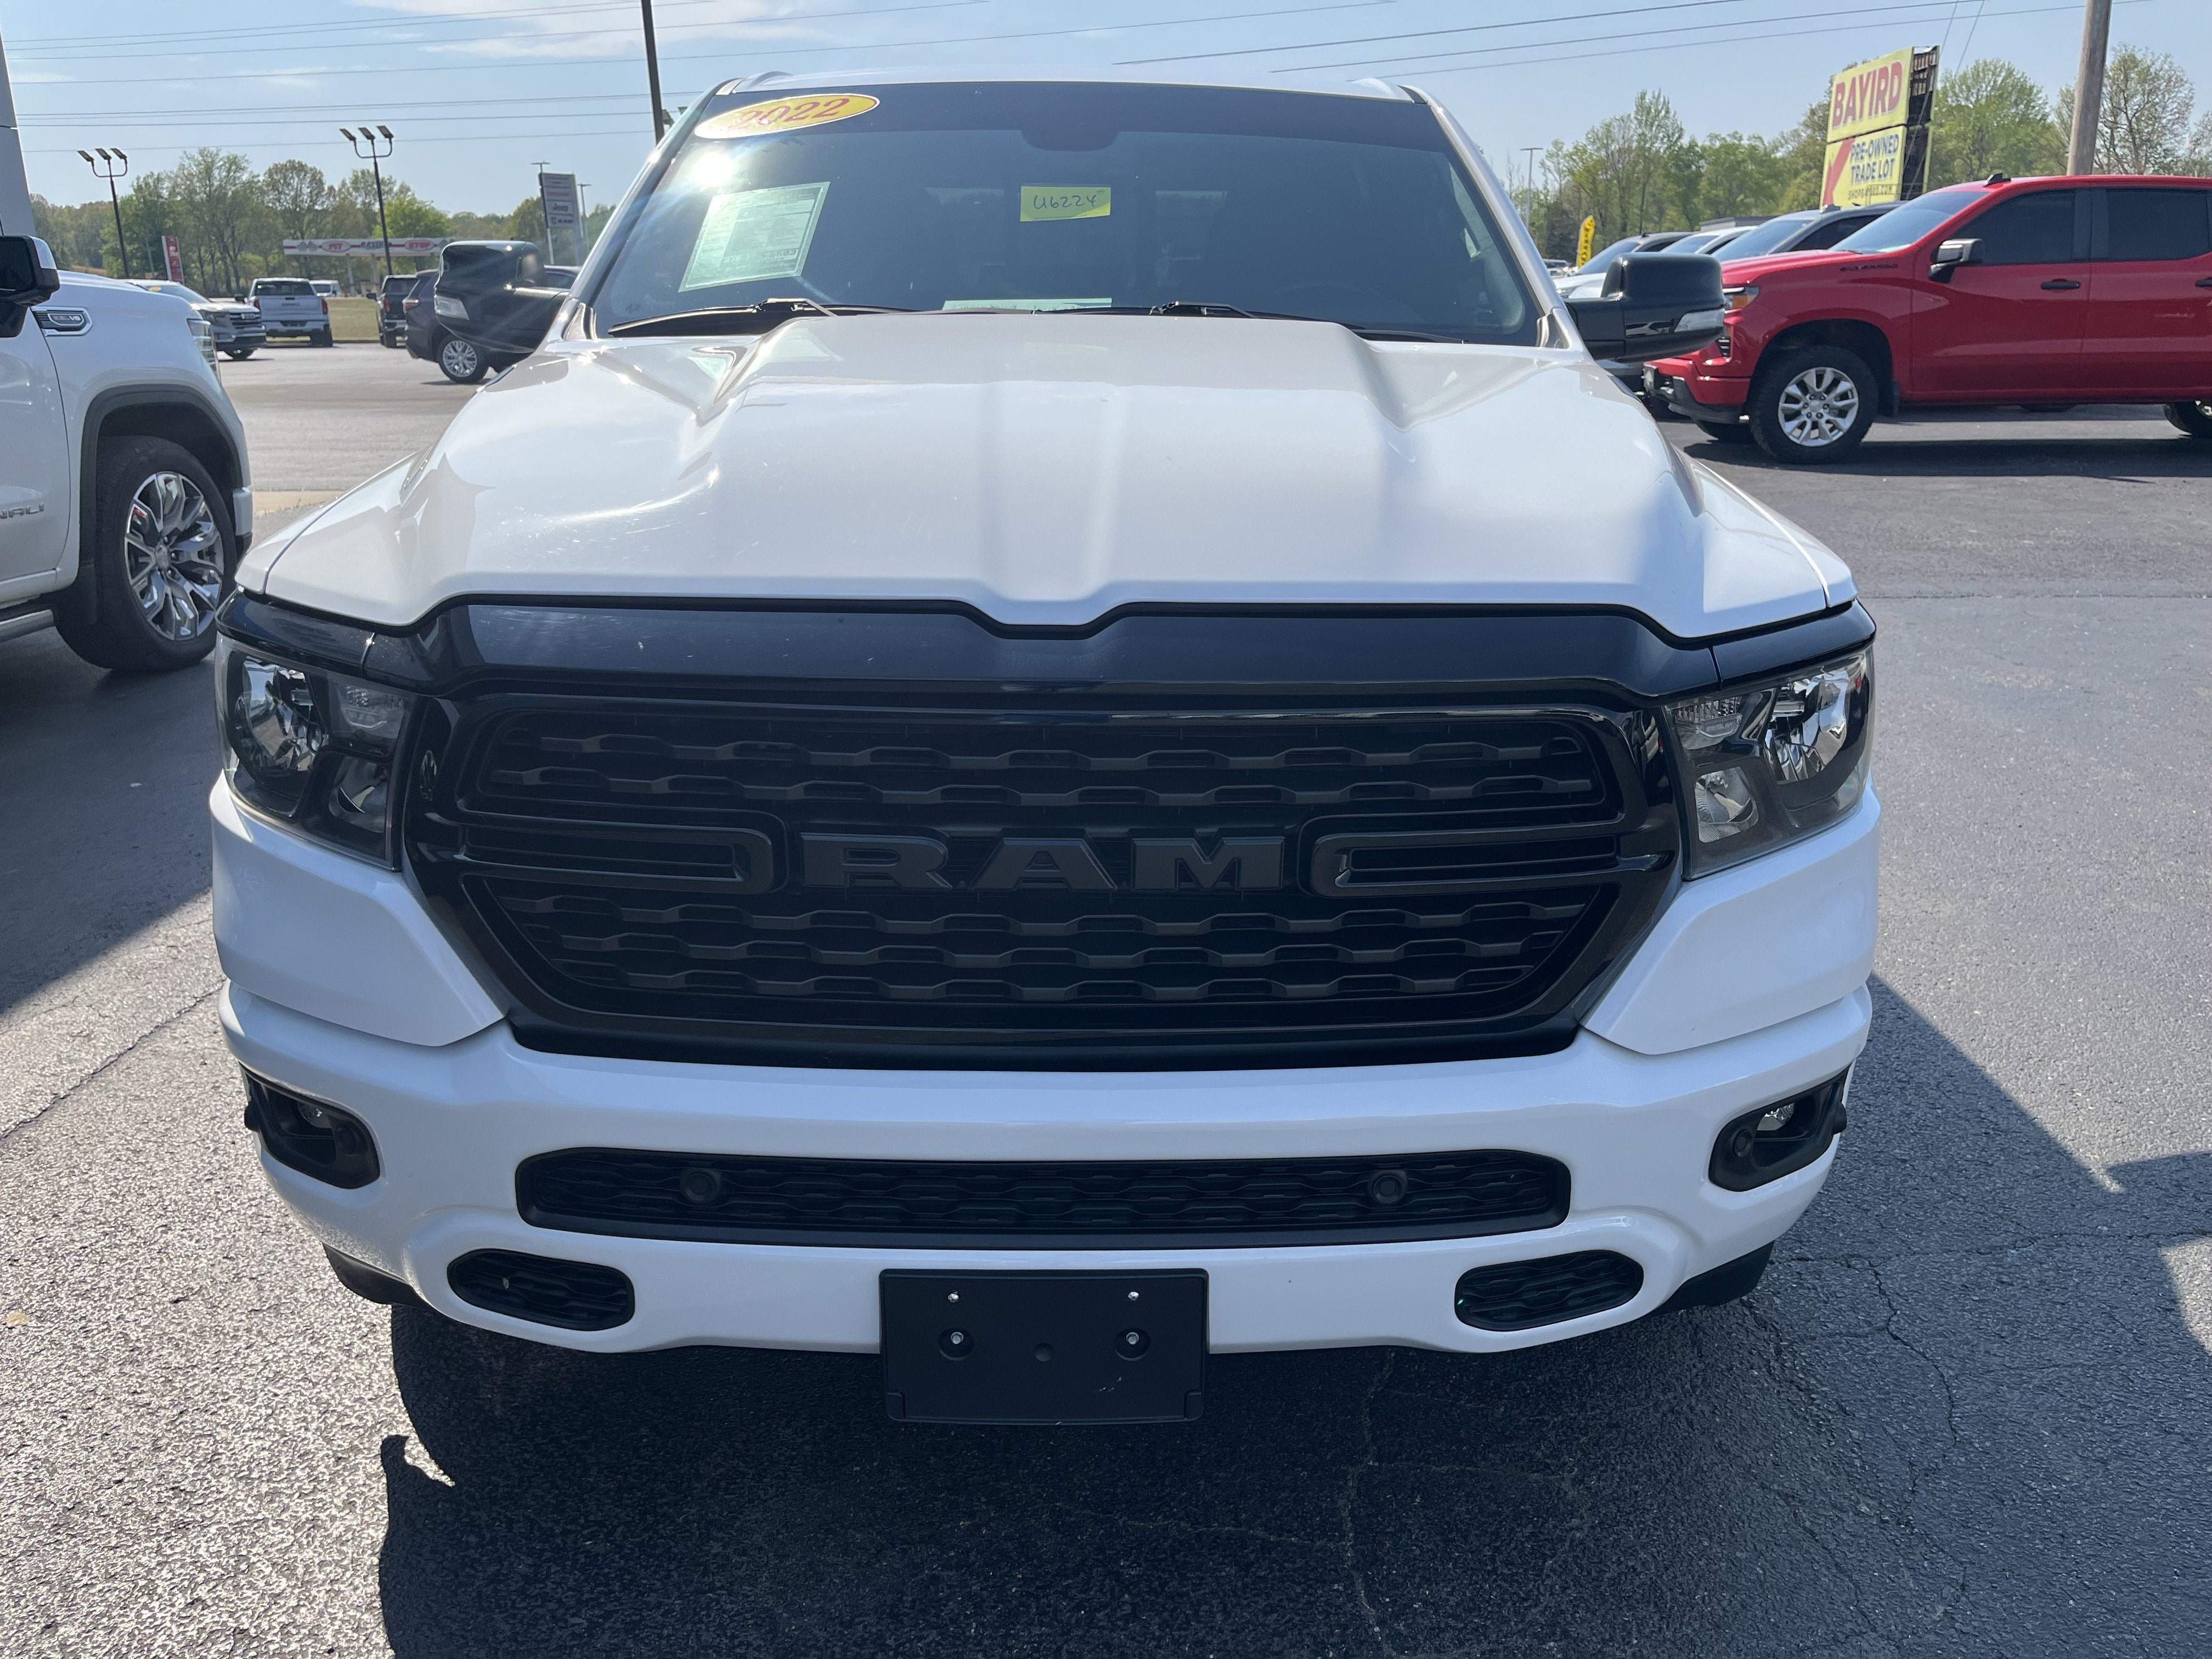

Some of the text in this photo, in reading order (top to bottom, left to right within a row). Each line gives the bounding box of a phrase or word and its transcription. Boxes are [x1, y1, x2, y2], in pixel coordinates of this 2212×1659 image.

[1832, 61, 1903, 128] BAYIRD
[729, 98, 850, 130] 2022
[1850, 134, 1899, 162] PRE-OWNED
[1850, 157, 1895, 184] TRADE LOT
[800, 832, 1285, 890] RAM
